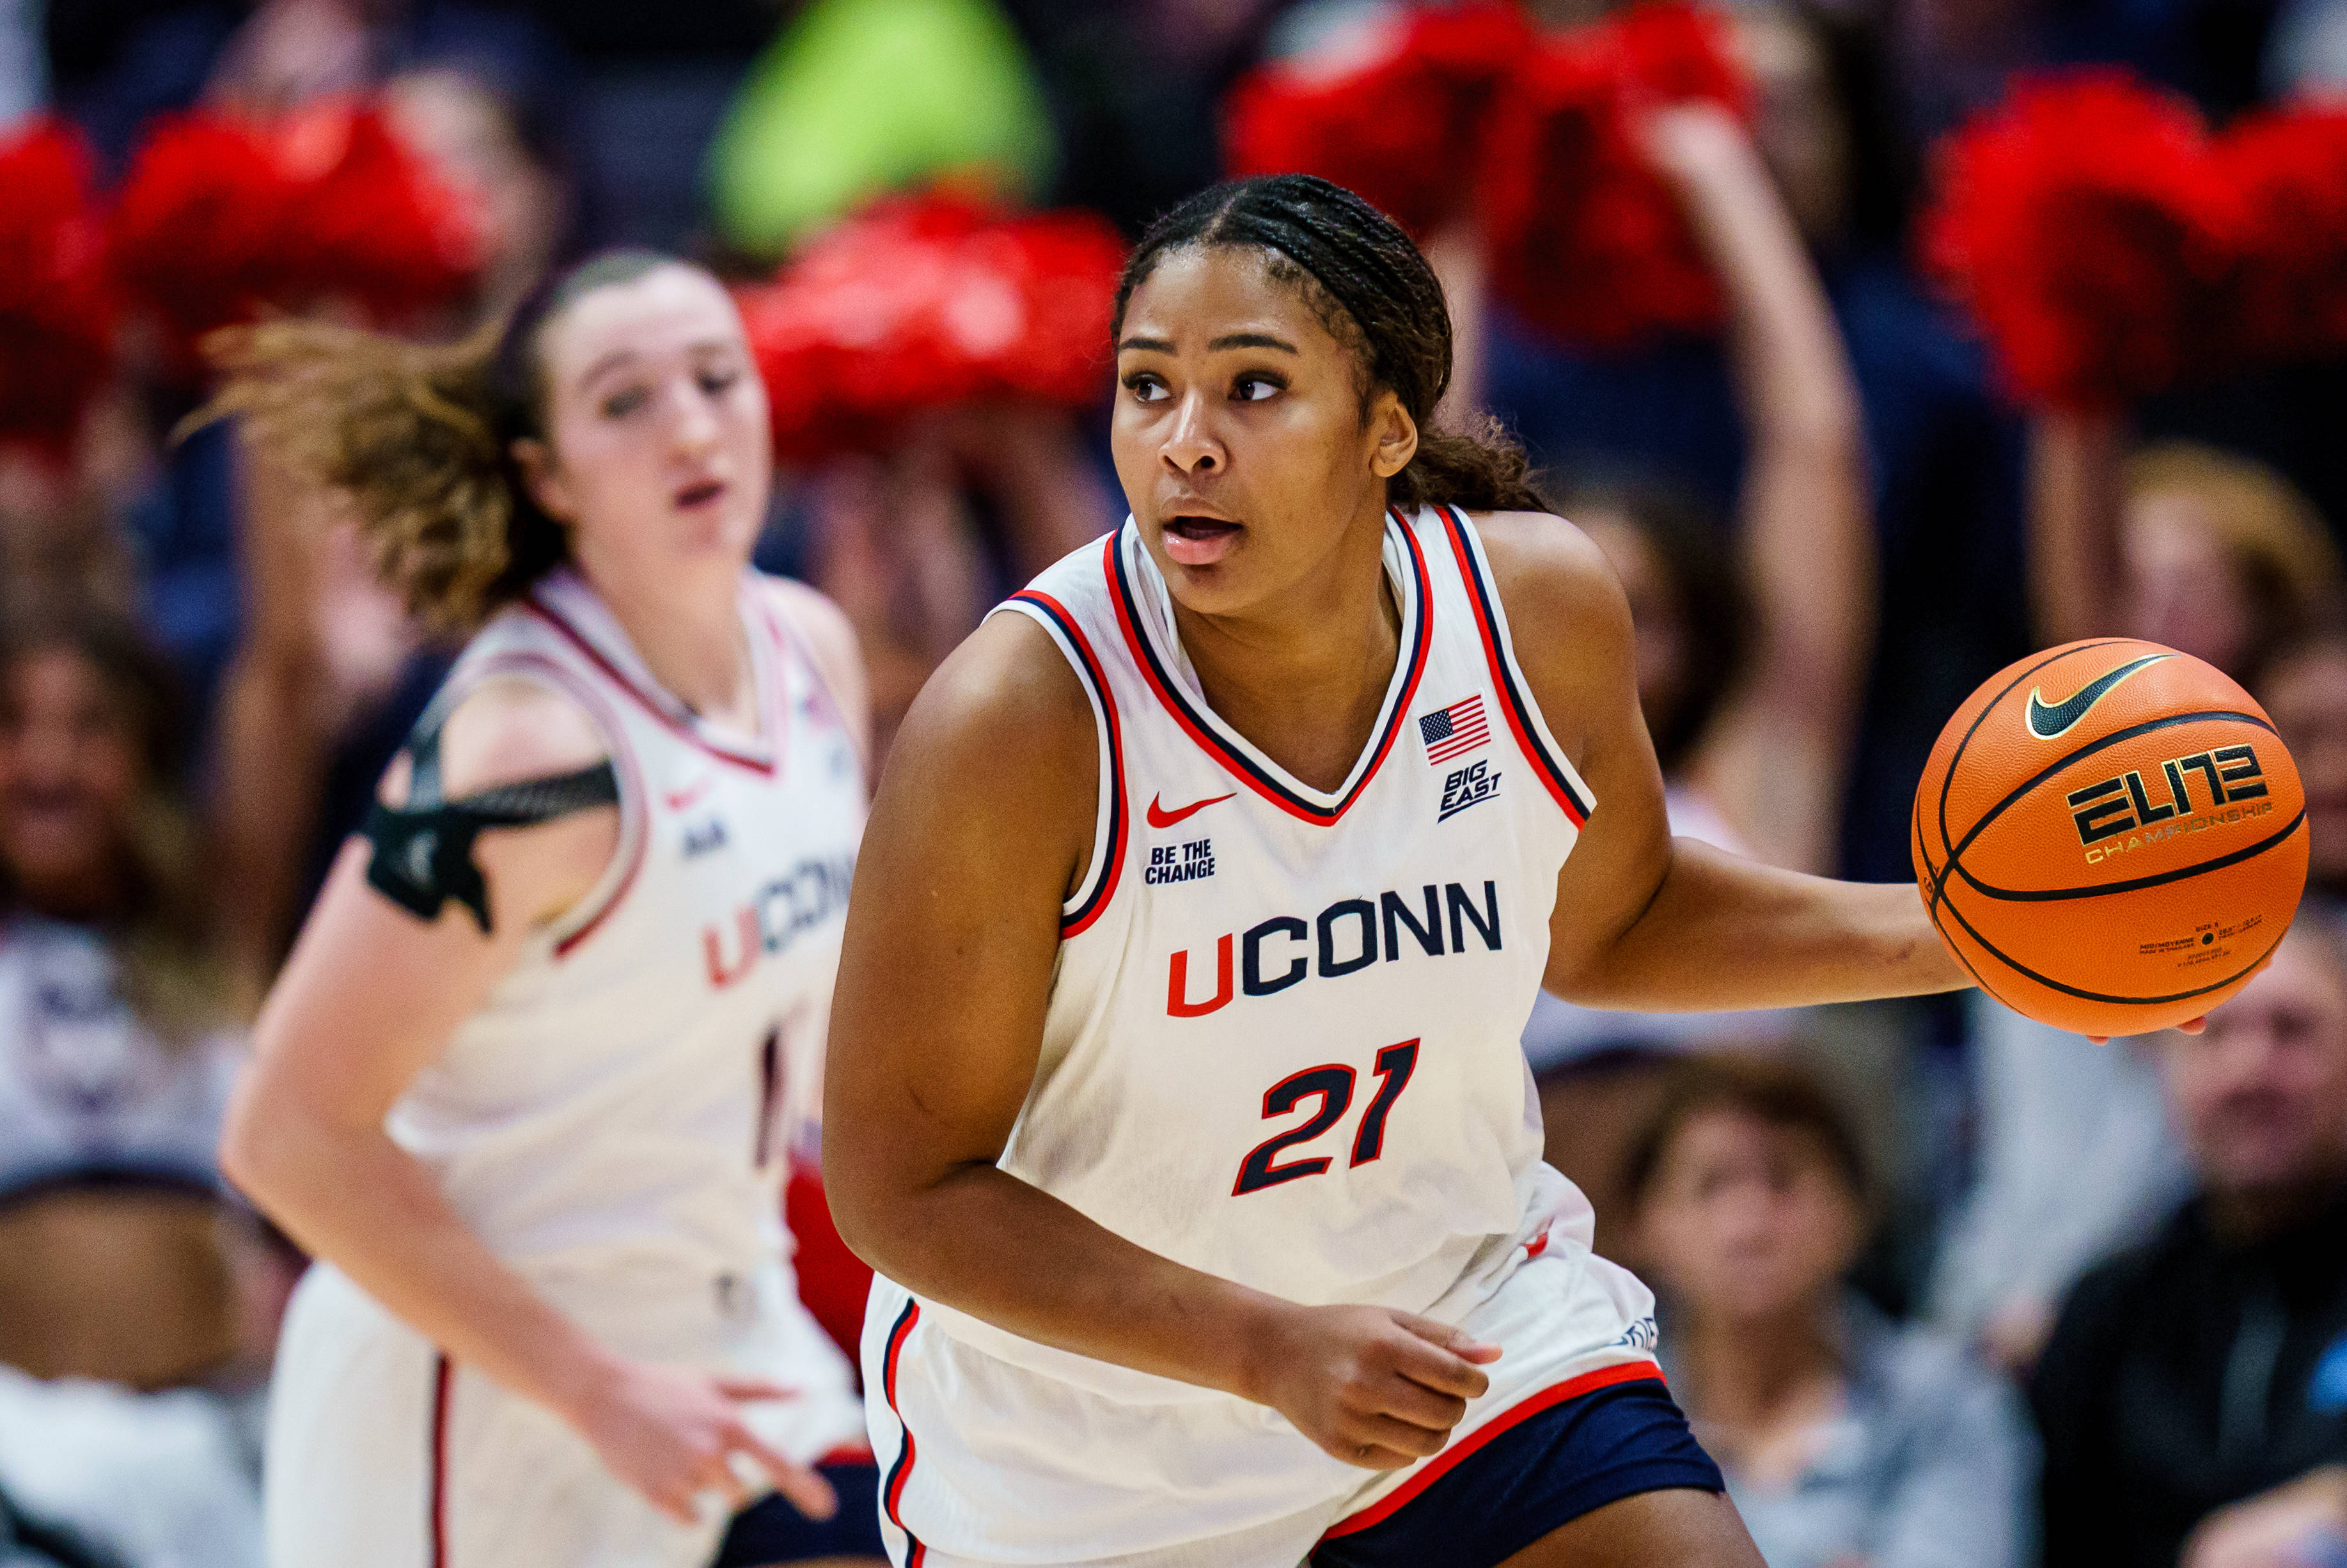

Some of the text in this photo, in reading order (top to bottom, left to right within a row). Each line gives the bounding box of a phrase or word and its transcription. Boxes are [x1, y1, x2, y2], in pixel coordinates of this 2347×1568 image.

[1440, 772, 1502, 810] EAST
[1445, 759, 1488, 790] BIG
[2066, 742, 2269, 847] ELITE
[1151, 838, 1212, 865] BE THE
[2085, 801, 2273, 865] CHAMPIONSHIP
[1145, 858, 1216, 885] CHANGE
[1166, 880, 1502, 1018] UCONN
[1231, 1037, 1421, 1197] 21
